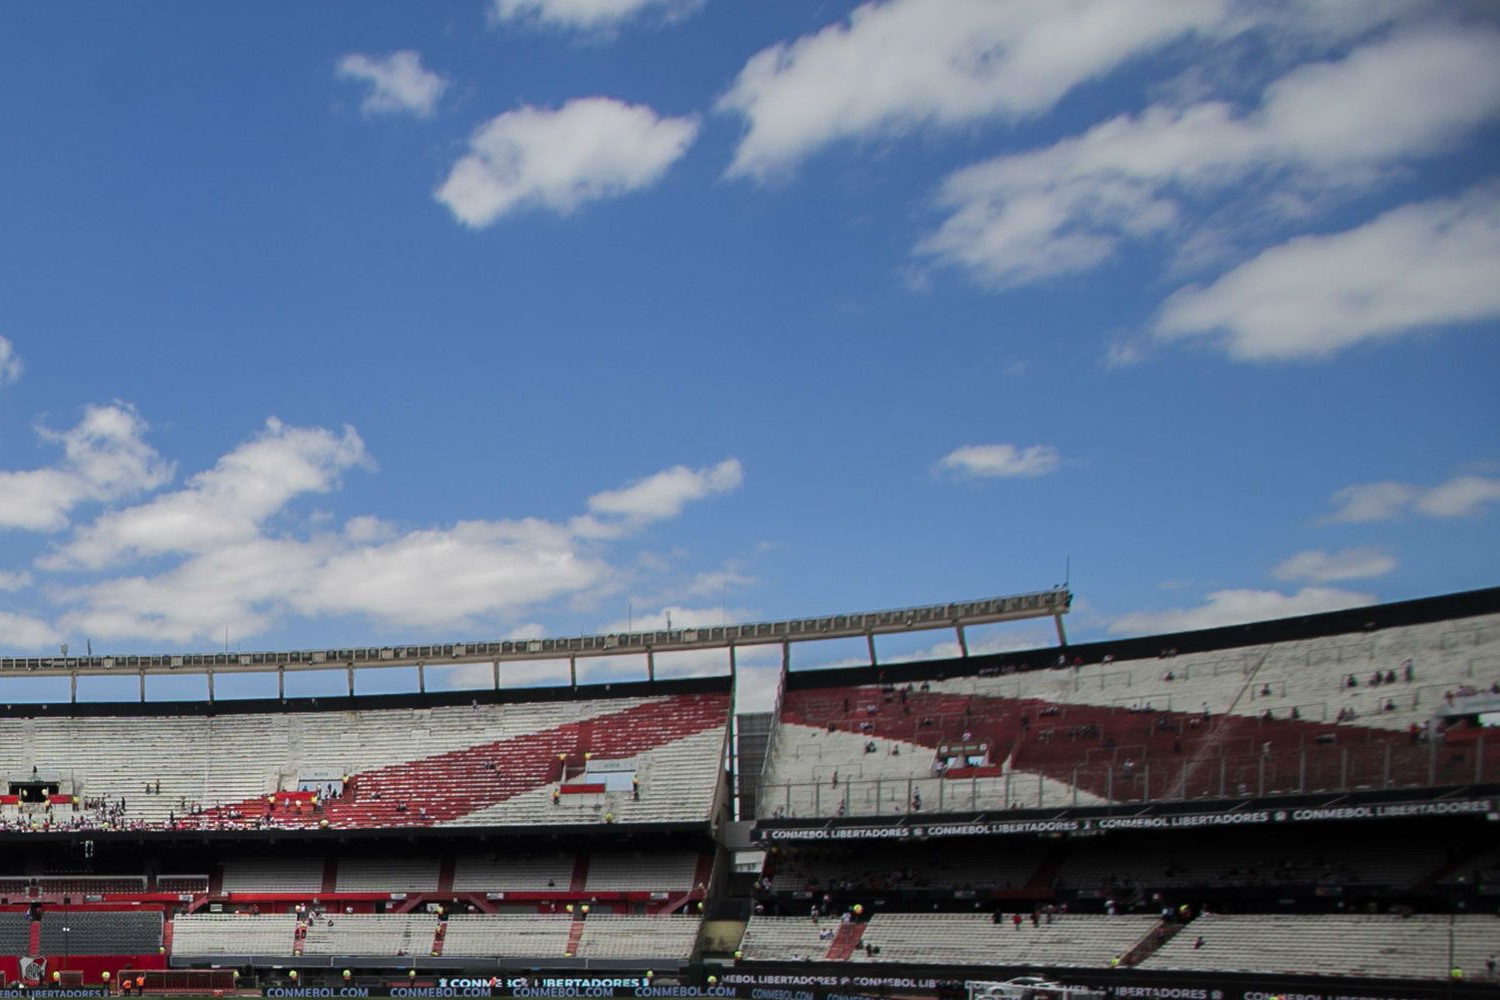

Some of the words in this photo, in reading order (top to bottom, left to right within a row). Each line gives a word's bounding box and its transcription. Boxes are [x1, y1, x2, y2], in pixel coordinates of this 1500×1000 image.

[1376, 799, 1491, 818] LIBERTADORES
[771, 829, 830, 839] CONMEBOL
[830, 826, 909, 838] LIBERTADORES
[26, 989, 101, 999] LIBERTADORES
[267, 987, 368, 998] CONMEBOL.COM
[389, 987, 491, 998] CONMEBOL.COM
[513, 987, 613, 998] CONMEBOL.COM
[635, 987, 737, 998] CONMEBOL.COM
